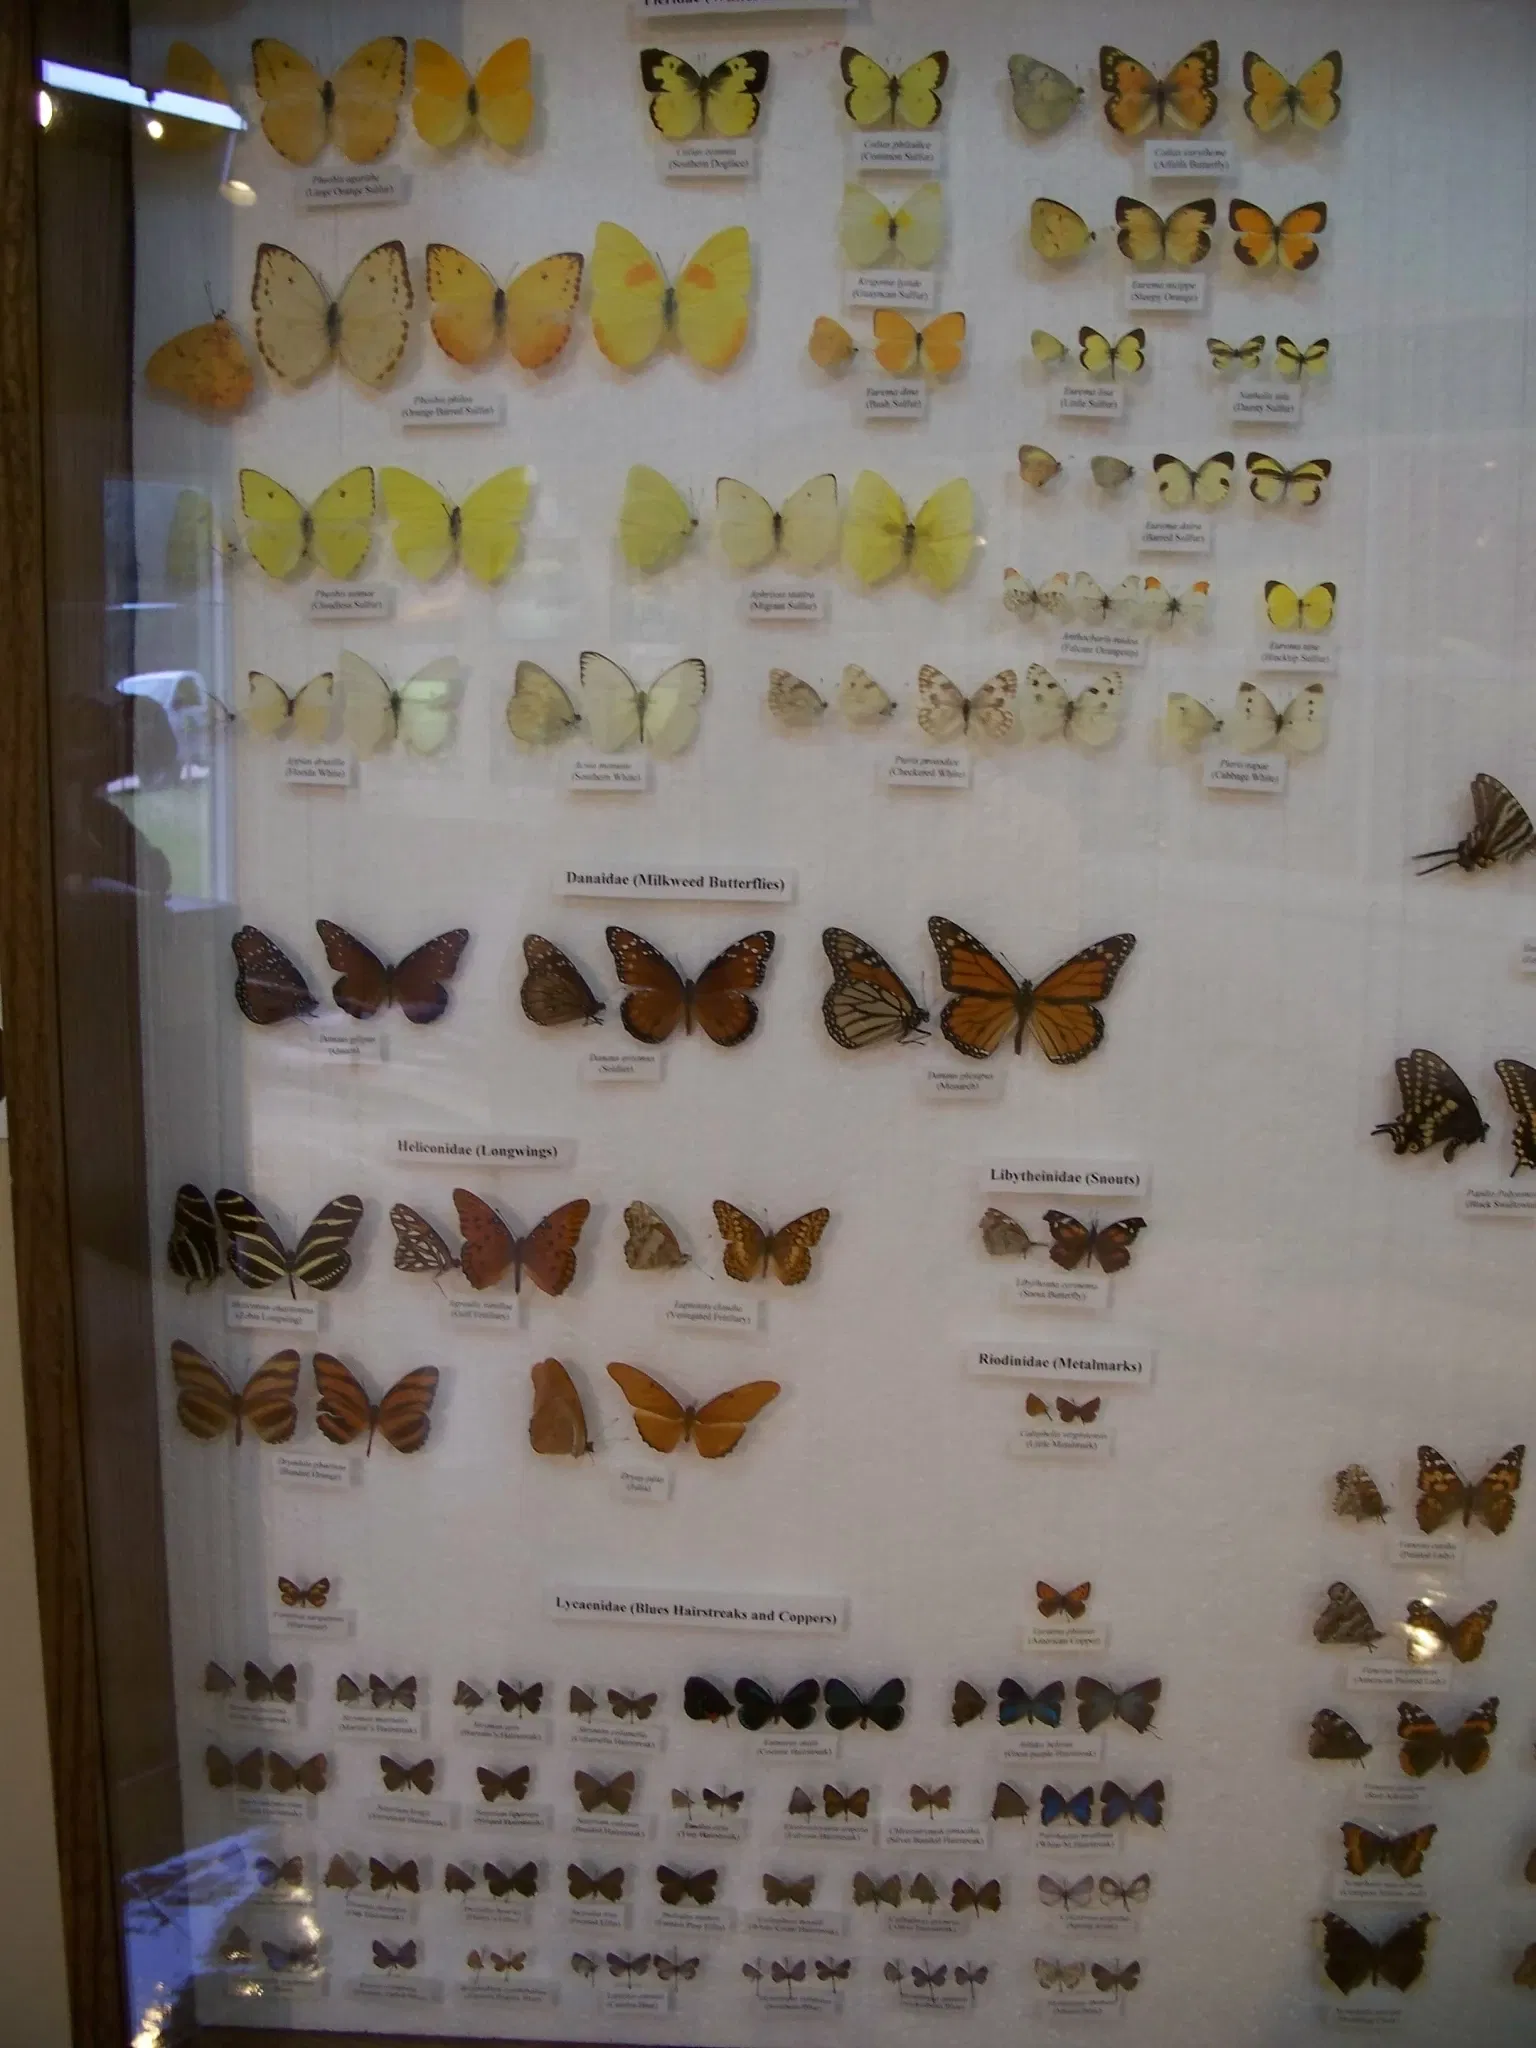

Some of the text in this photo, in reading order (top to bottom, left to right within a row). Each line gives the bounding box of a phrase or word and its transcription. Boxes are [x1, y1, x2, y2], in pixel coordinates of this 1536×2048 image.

[566, 871, 785, 894] Danaidae (Milkweed Butterflies)
[397, 1140, 559, 1161] Heliconidae (Longwings)
[990, 1168, 1141, 1188] Libytheinidae (Snouts)
[979, 1353, 1142, 1374] Riodinidae (Metalmarks)
[555, 1596, 839, 1628] Lycaenidae (Blues Hairstreaks and Coppers)
